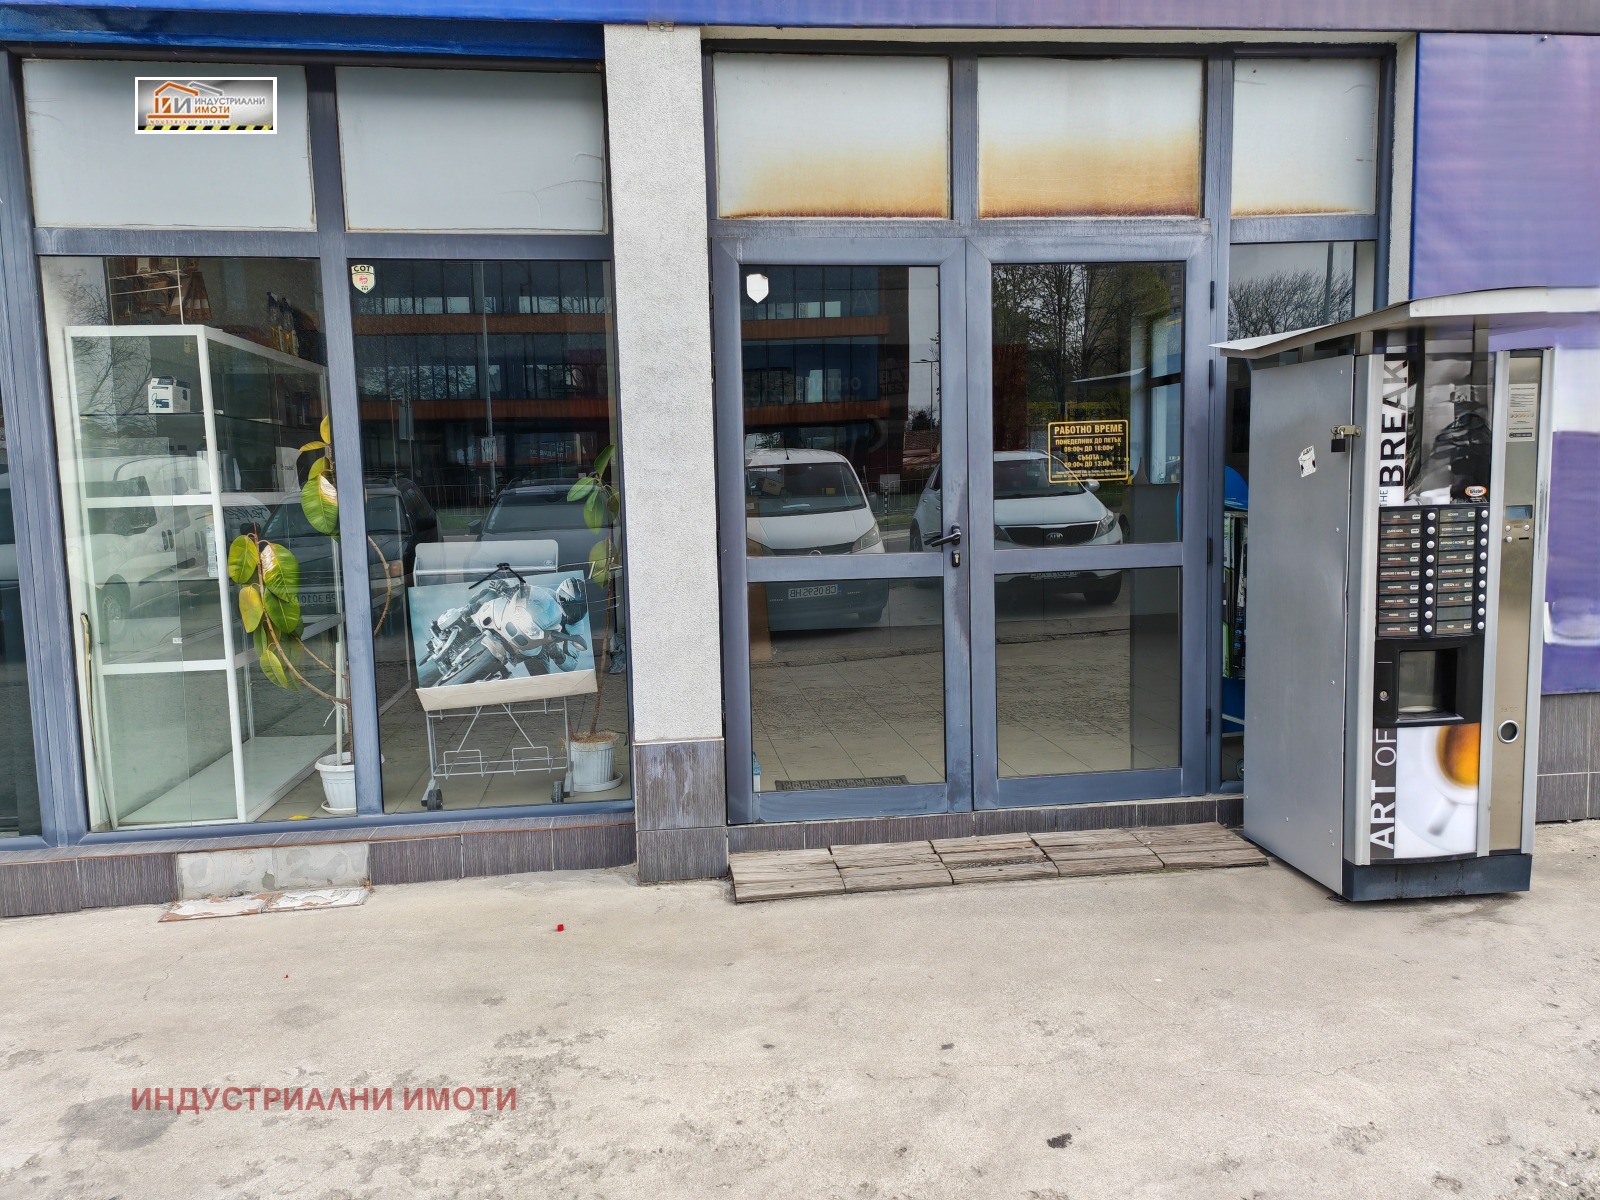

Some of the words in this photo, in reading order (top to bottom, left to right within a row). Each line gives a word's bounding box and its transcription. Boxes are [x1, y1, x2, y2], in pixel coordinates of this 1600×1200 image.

[1054, 425, 1092, 435] РАБОТНО
[1094, 424, 1123, 433] ВРЕМЕ
[1379, 360, 1408, 487] BREAK
[1375, 728, 1396, 766] OF
[1370, 780, 1396, 849] ART
